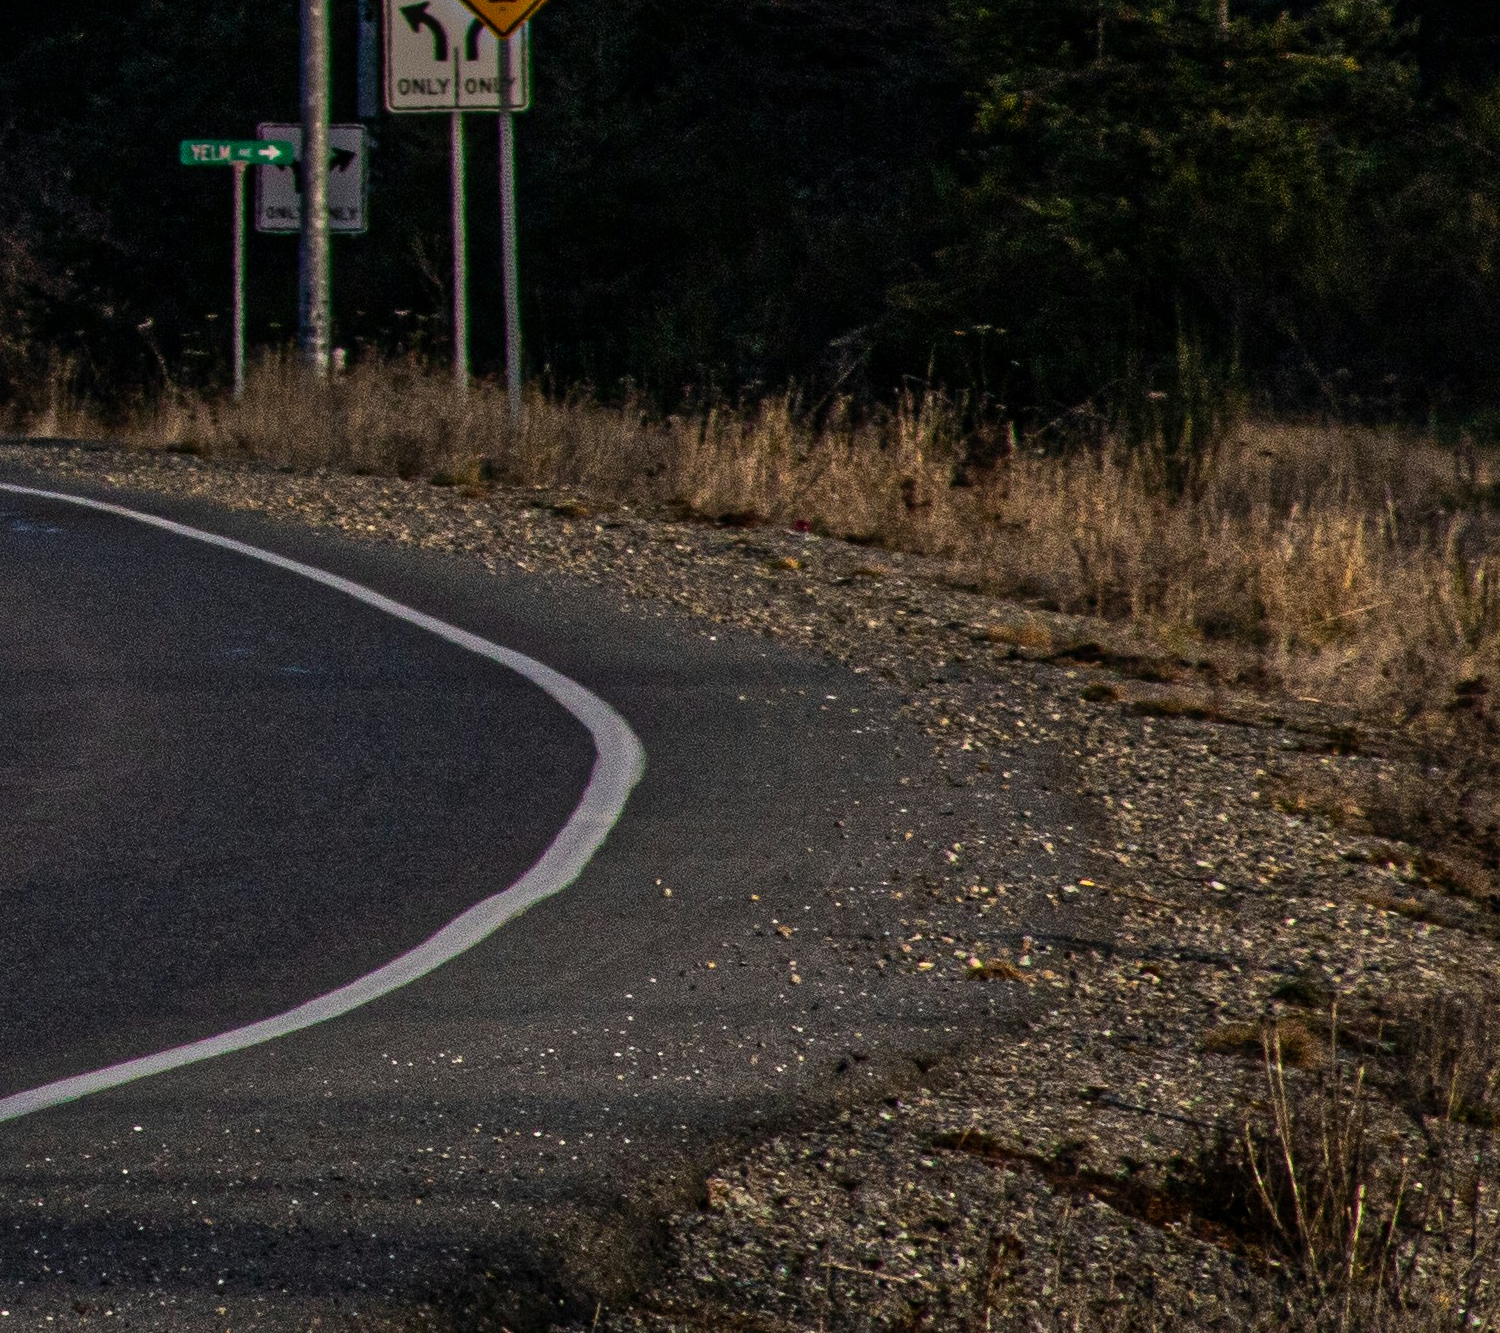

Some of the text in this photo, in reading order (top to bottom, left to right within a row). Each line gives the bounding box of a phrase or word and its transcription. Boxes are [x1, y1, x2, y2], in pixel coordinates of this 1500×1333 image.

[398, 77, 450, 95] ONLY
[191, 144, 231, 161] YELM
[266, 206, 301, 220] ONL
